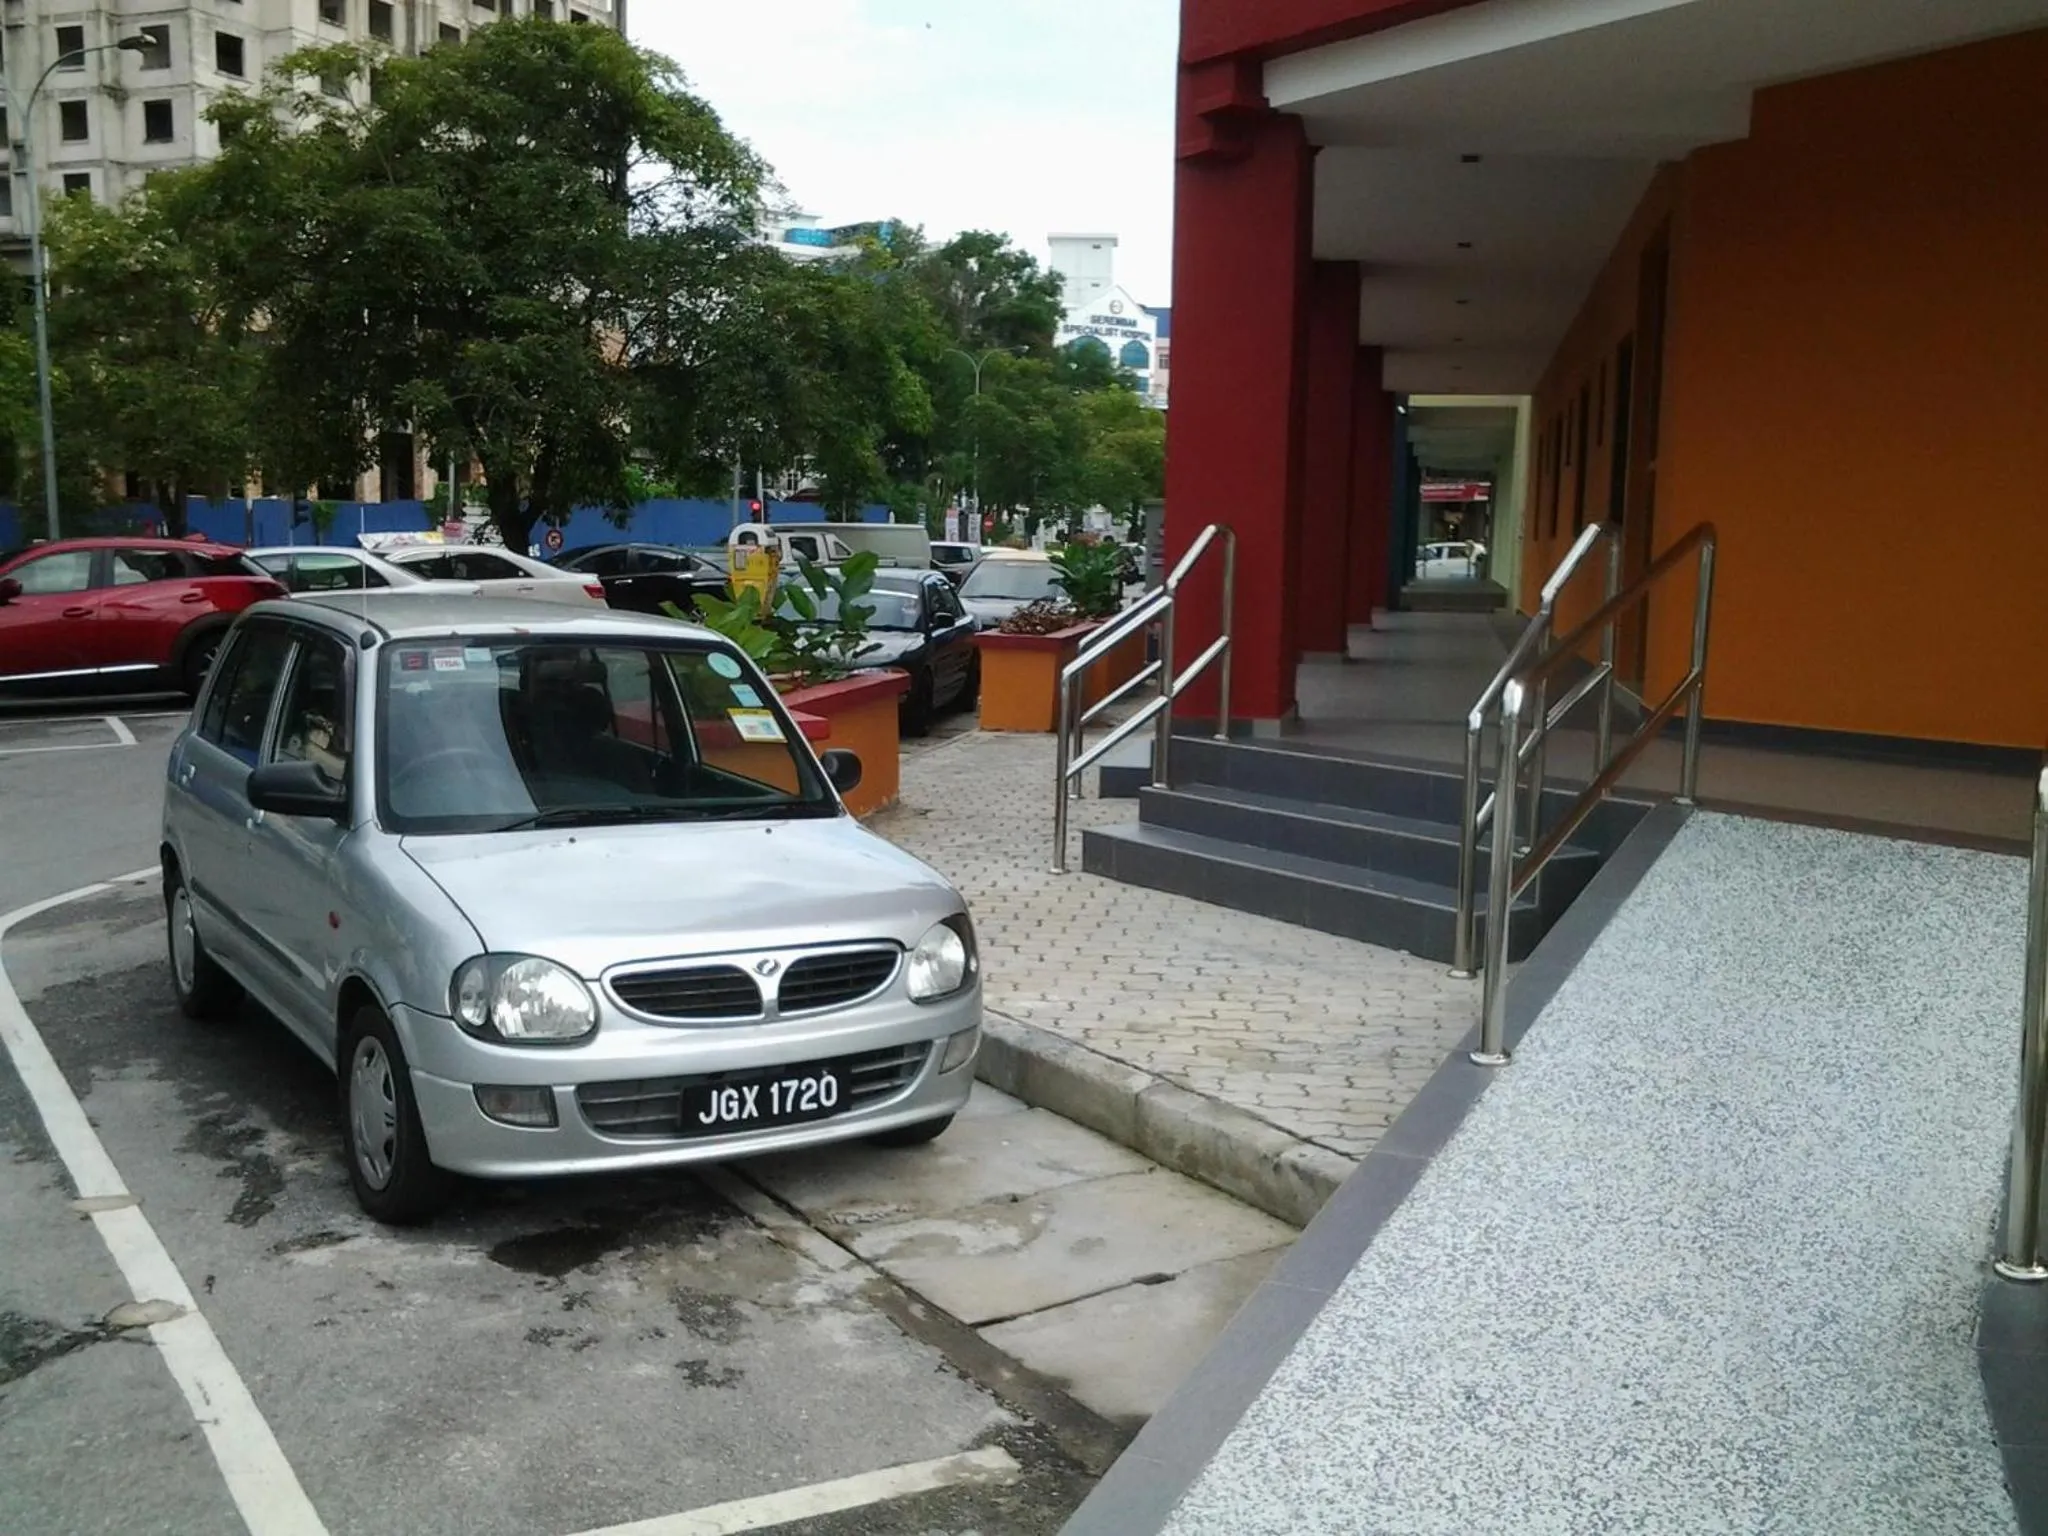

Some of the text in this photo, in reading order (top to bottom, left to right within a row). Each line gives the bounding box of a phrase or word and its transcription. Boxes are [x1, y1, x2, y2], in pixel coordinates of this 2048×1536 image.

[1063, 325, 1118, 337] SPECIALIST
[699, 1075, 838, 1125] JGX 1720
